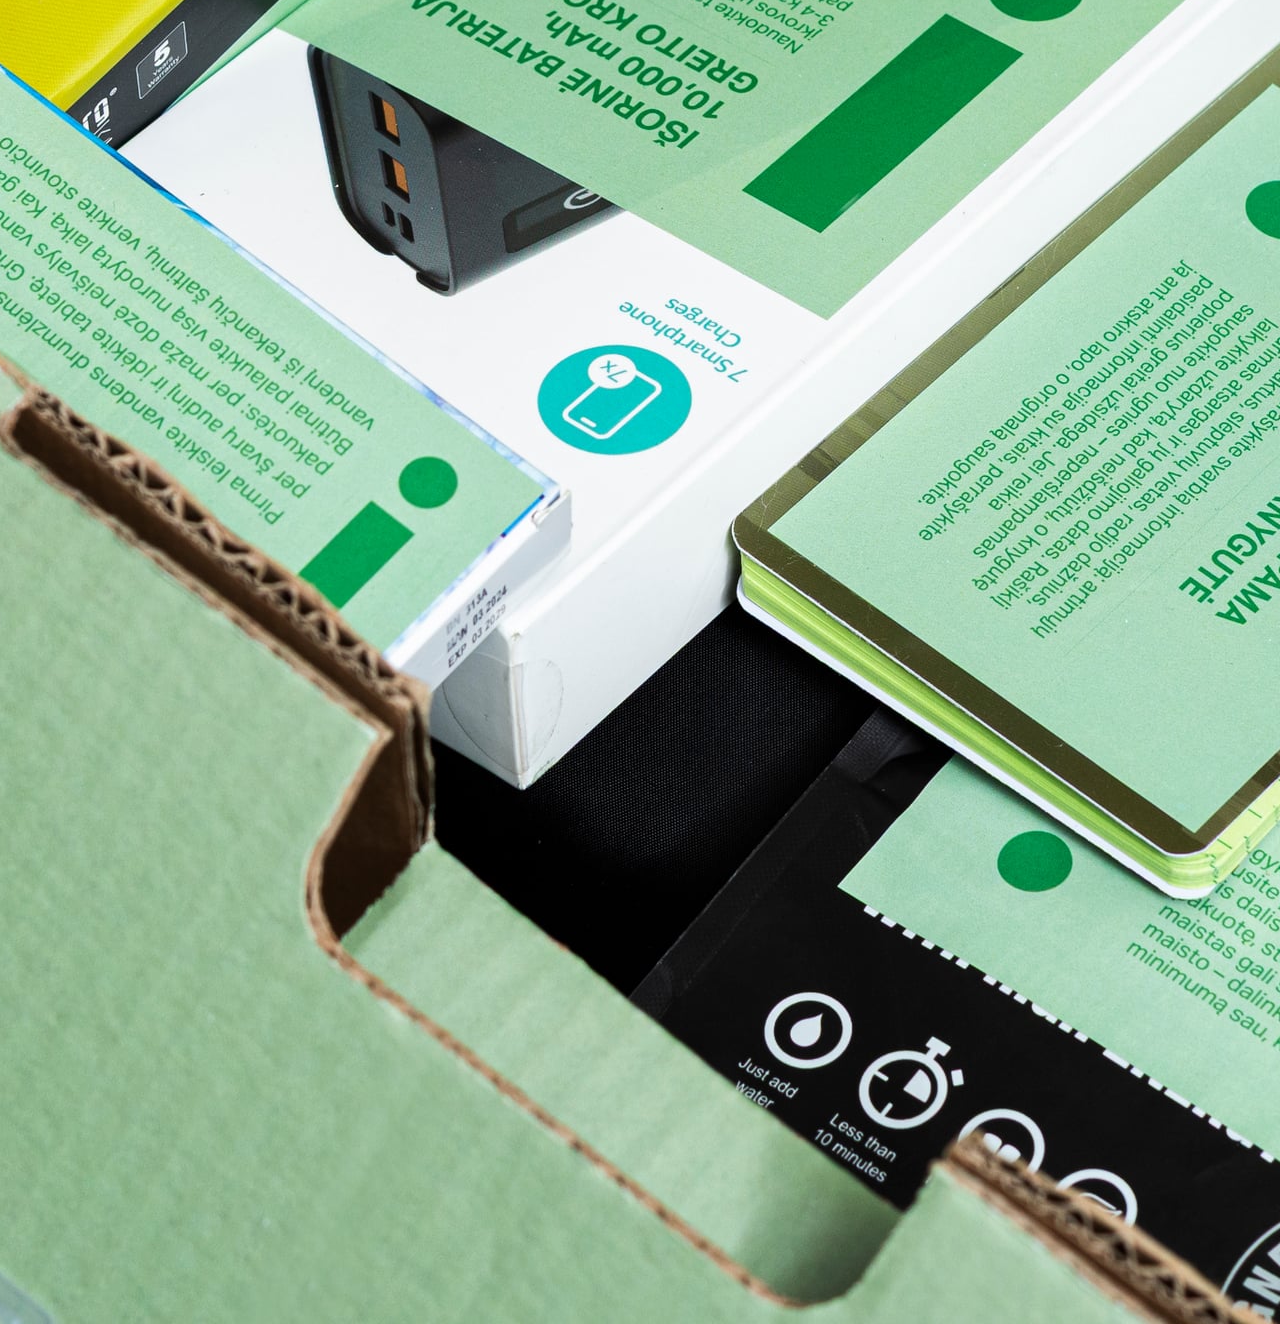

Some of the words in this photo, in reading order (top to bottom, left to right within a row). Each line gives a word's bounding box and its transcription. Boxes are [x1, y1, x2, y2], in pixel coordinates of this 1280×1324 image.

[544, 9, 622, 61] mAh,
[754, 1, 823, 41] įkrovos
[799, 4, 835, 27] 3-4
[147, 56, 181, 88] Warranty
[154, 39, 171, 67] 5
[634, 23, 759, 94] GREITO
[557, 67, 700, 149] IŠORINĖ
[617, 55, 725, 119] 10,000
[32, 241, 116, 309] neišvalys
[112, 304, 160, 343] dozė
[618, 301, 734, 373] Smartphone
[664, 297, 741, 348] Charges
[158, 339, 210, 382] maža
[726, 368, 748, 383] 7
[88, 365, 165, 430] vandens
[206, 379, 246, 407] per
[1177, 378, 1243, 436] atsargas
[164, 425, 231, 483] leiskite
[239, 402, 334, 476] pakuotės:
[1146, 440, 1175, 462] jų
[1167, 434, 1187, 449] ir
[228, 475, 285, 525] Pirma
[1087, 457, 1155, 520] galiojimo
[1171, 455, 1232, 505] svarbią
[1040, 519, 1090, 559] datas.
[1092, 503, 1184, 582] informaciją:
[988, 560, 1049, 610] Rašiklį
[1028, 579, 1098, 639] artimųjų
[448, 642, 468, 668] EXP
[1141, 922, 1210, 971] maisto
[1125, 941, 1228, 1015] minimumą
[1228, 1008, 1268, 1042] sau,
[735, 1080, 775, 1110] water
[738, 1057, 771, 1081] Just
[769, 1075, 799, 1099] add
[813, 1128, 833, 1147] 10
[832, 1142, 888, 1183] minutes
[829, 1113, 864, 1142] Less
[864, 1135, 898, 1163] than
